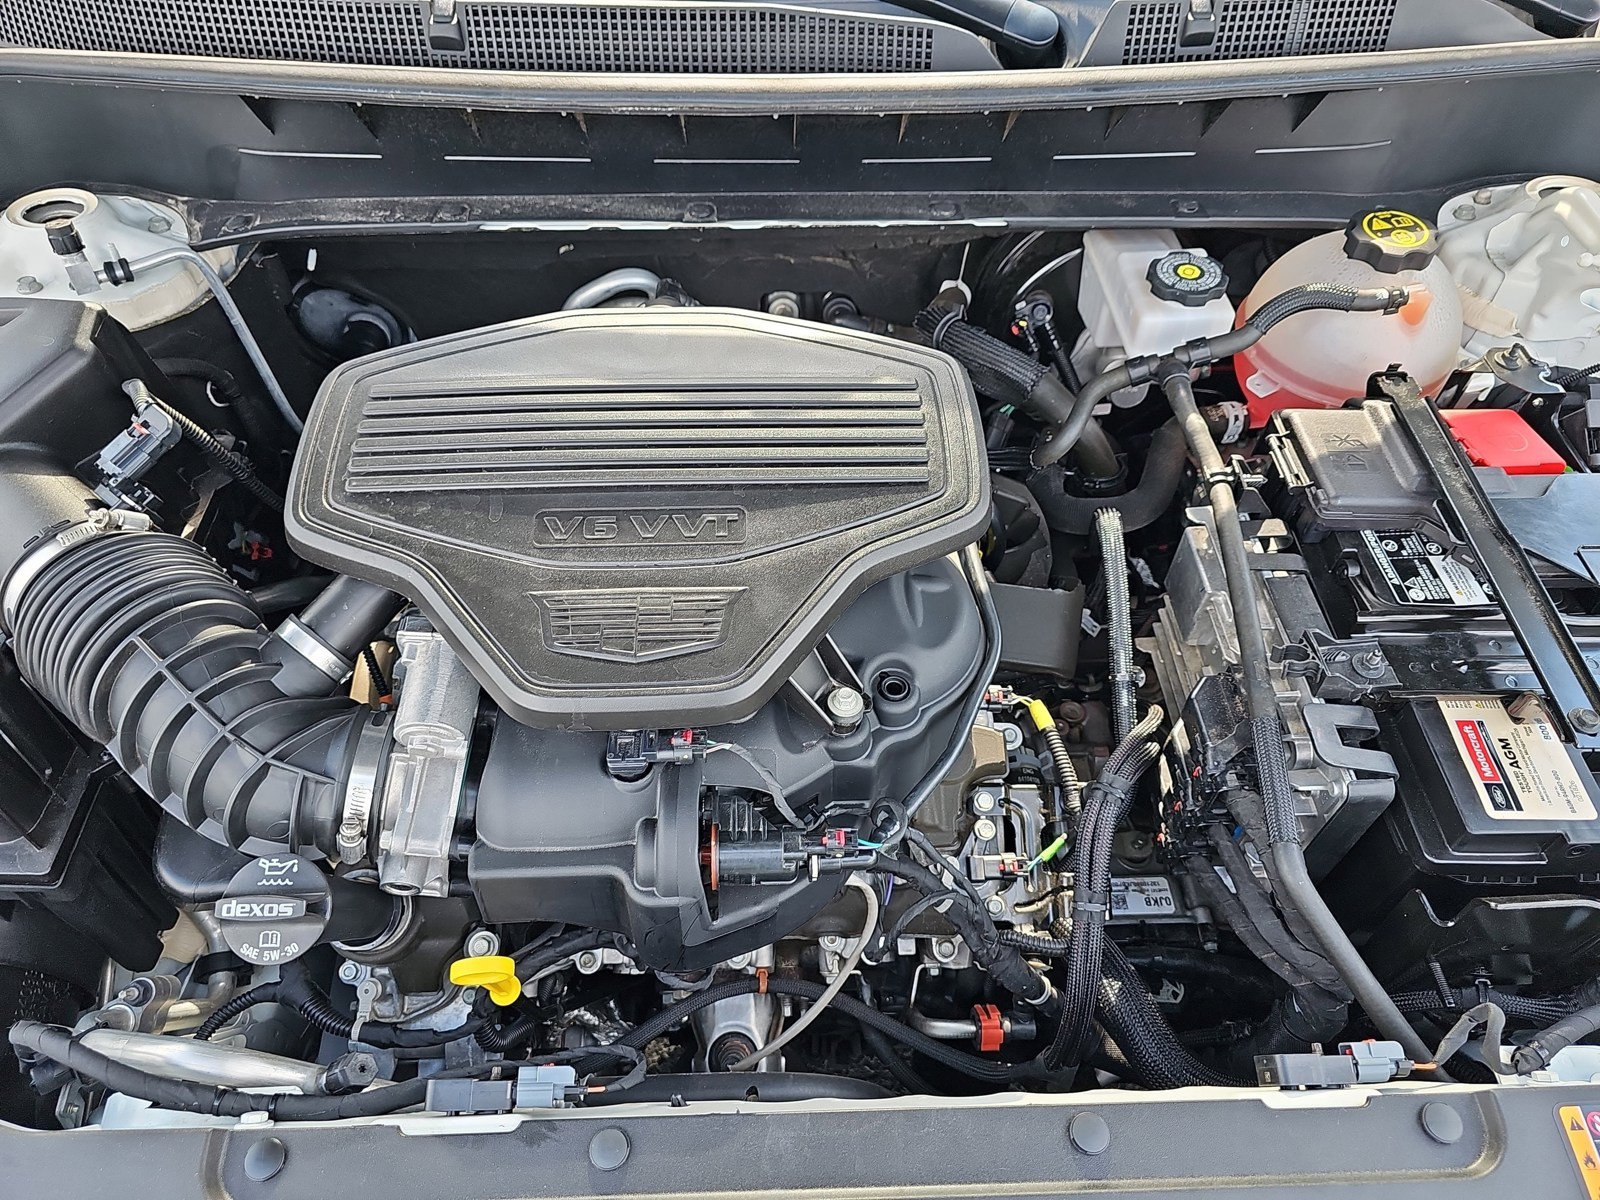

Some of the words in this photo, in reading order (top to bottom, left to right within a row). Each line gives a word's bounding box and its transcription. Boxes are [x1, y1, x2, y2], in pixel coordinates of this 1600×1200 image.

[543, 516, 618, 540] V6
[630, 514, 739, 538] VVT
[1538, 726, 1552, 740] 800
[1463, 725, 1494, 777] Motorcraft
[1497, 738, 1522, 769] AGM
[1513, 771, 1528, 793] TESTED
[221, 900, 294, 917] dexos
[240, 943, 259, 960] SAE
[263, 942, 299, 961] 5W-30
